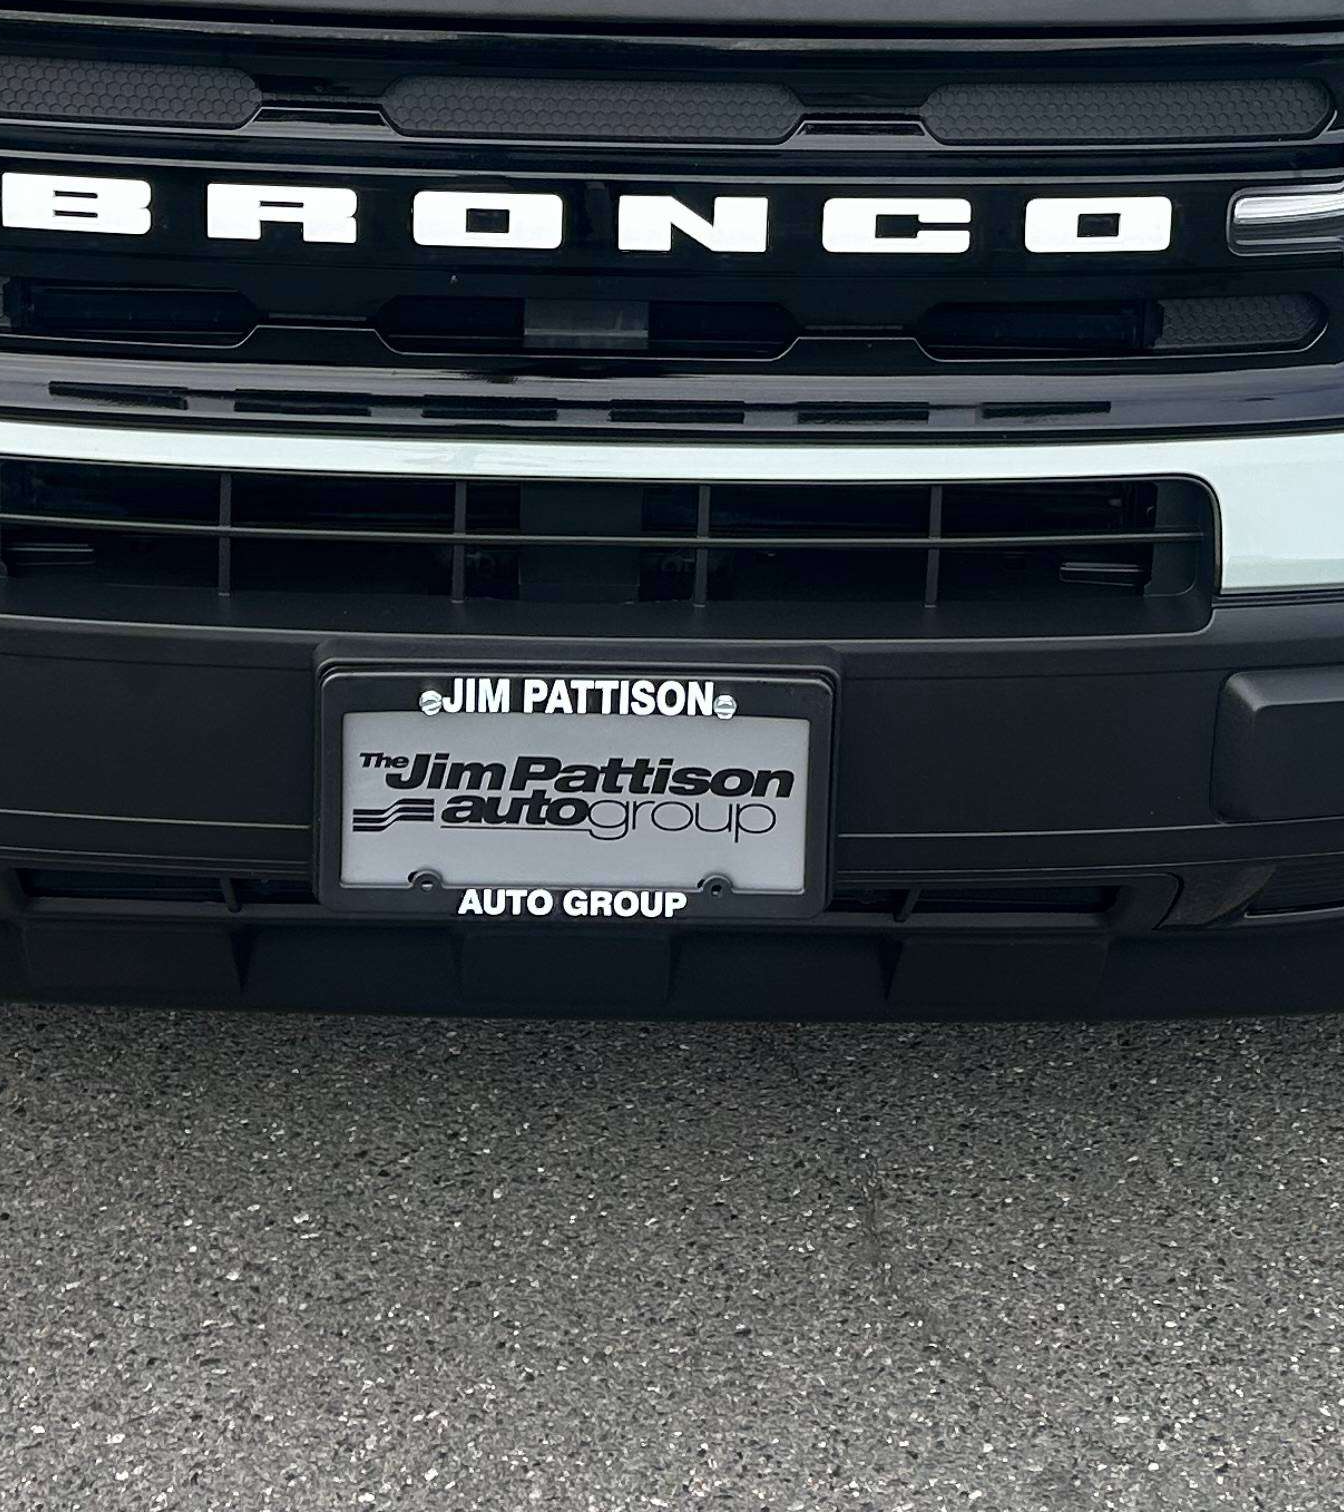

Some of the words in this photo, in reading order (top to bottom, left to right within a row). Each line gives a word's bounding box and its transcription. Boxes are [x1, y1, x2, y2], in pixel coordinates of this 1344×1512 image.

[1, 172, 1172, 253] BRONCO
[442, 678, 510, 713] JIM
[523, 679, 714, 716] PATTISON
[360, 752, 409, 768] The
[386, 752, 507, 790] Jim
[509, 756, 794, 798] Pattison
[458, 888, 554, 916] AUTO
[563, 890, 688, 918] GROUP
